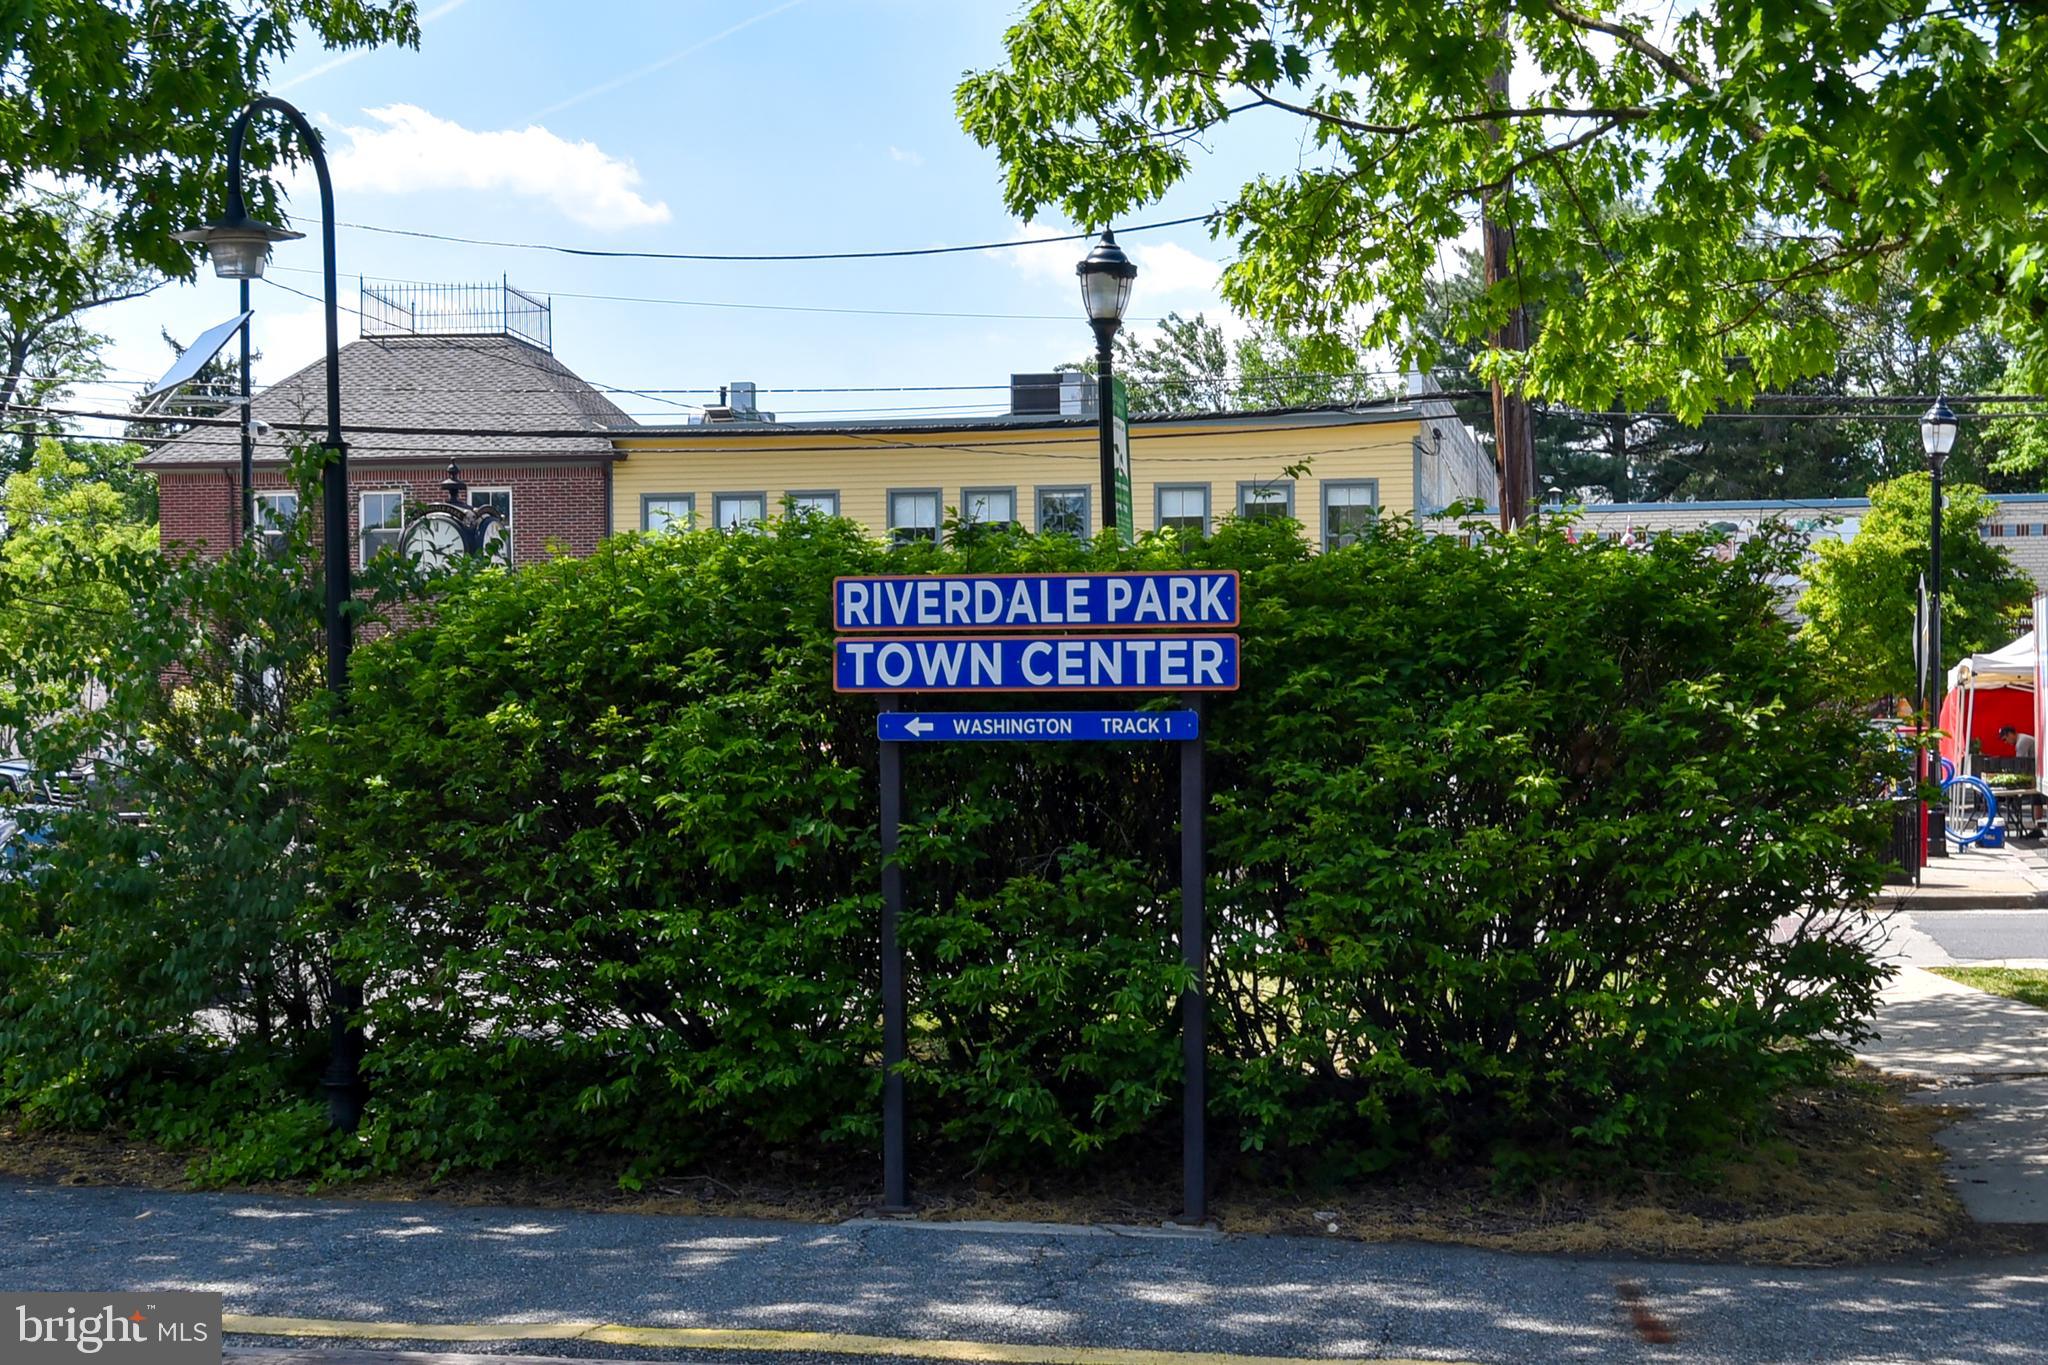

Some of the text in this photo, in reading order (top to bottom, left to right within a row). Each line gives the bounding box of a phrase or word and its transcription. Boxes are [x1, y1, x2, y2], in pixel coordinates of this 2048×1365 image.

[843, 576, 1229, 625] RIVERDALE PARK
[845, 640, 1224, 686] TOWN CENTER
[953, 717, 1171, 734] WASHINGTON TRACK 1
